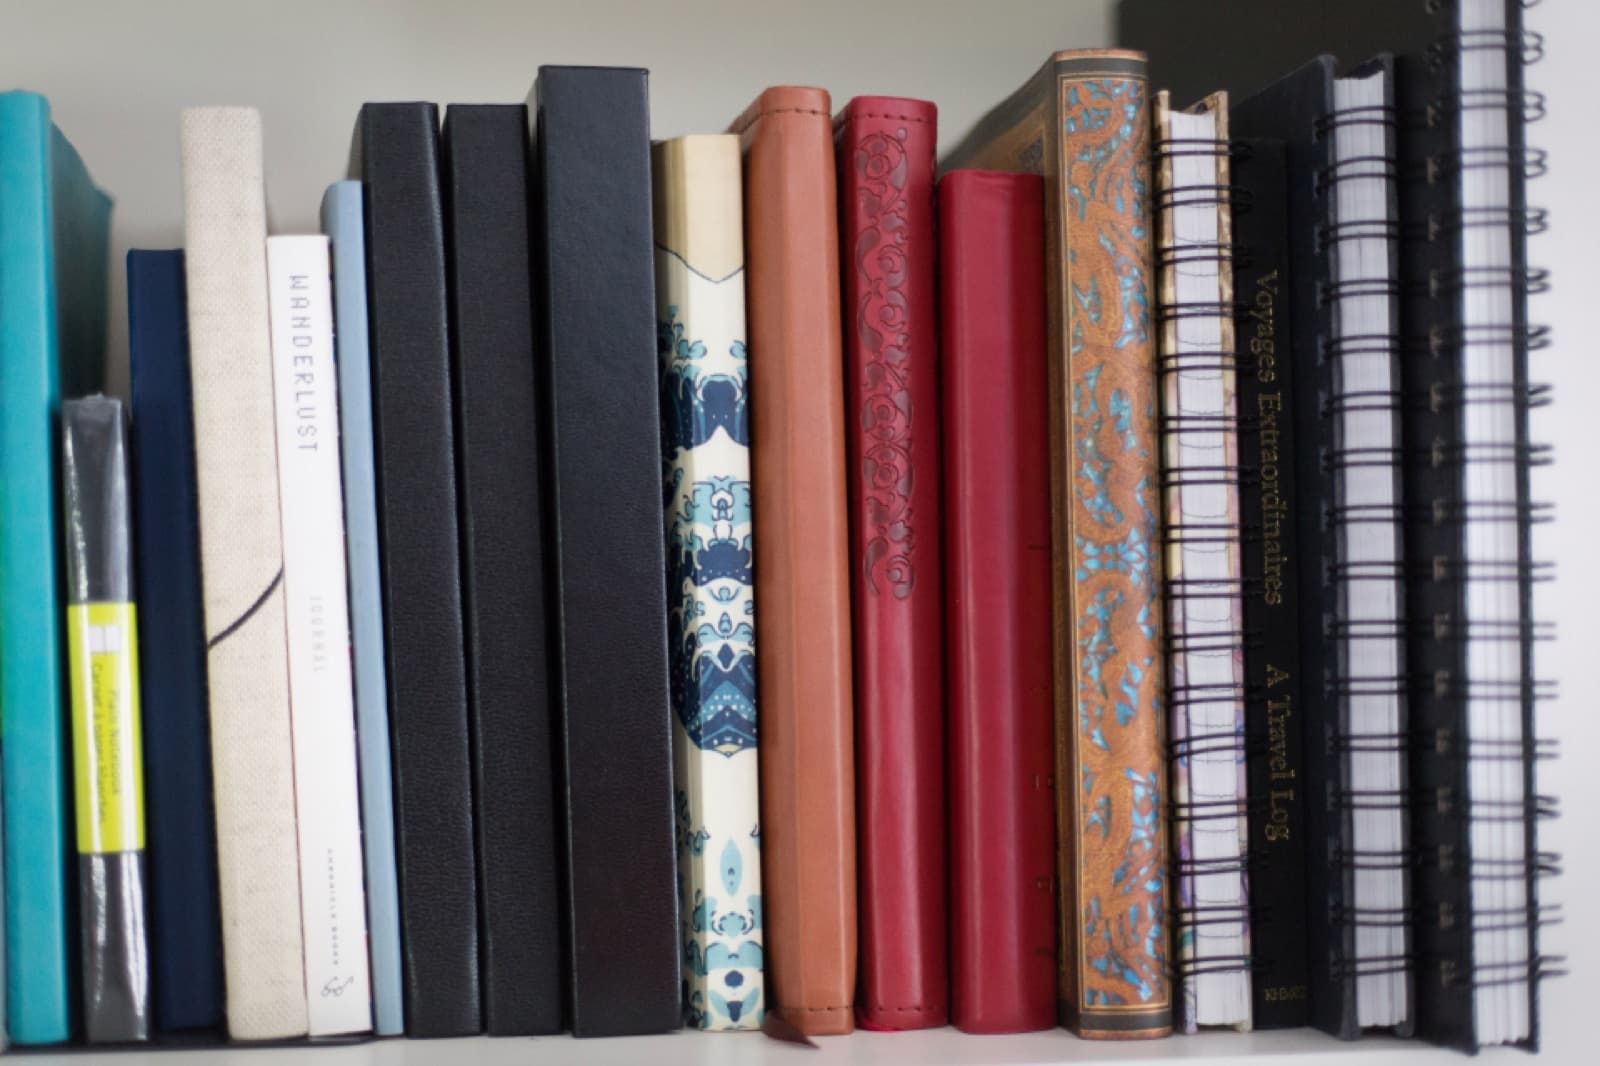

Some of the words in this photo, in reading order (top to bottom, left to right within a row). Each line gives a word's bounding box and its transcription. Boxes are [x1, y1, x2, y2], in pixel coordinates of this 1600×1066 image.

[289, 275, 318, 451] WANDERLUST
[1250, 269, 1278, 383] Voyages
[1258, 392, 1288, 604] Extraordinaires
[310, 596, 328, 672] JOURNAL
[1266, 663, 1289, 688] A
[1267, 695, 1295, 779] Travel
[1265, 789, 1294, 840] Log
